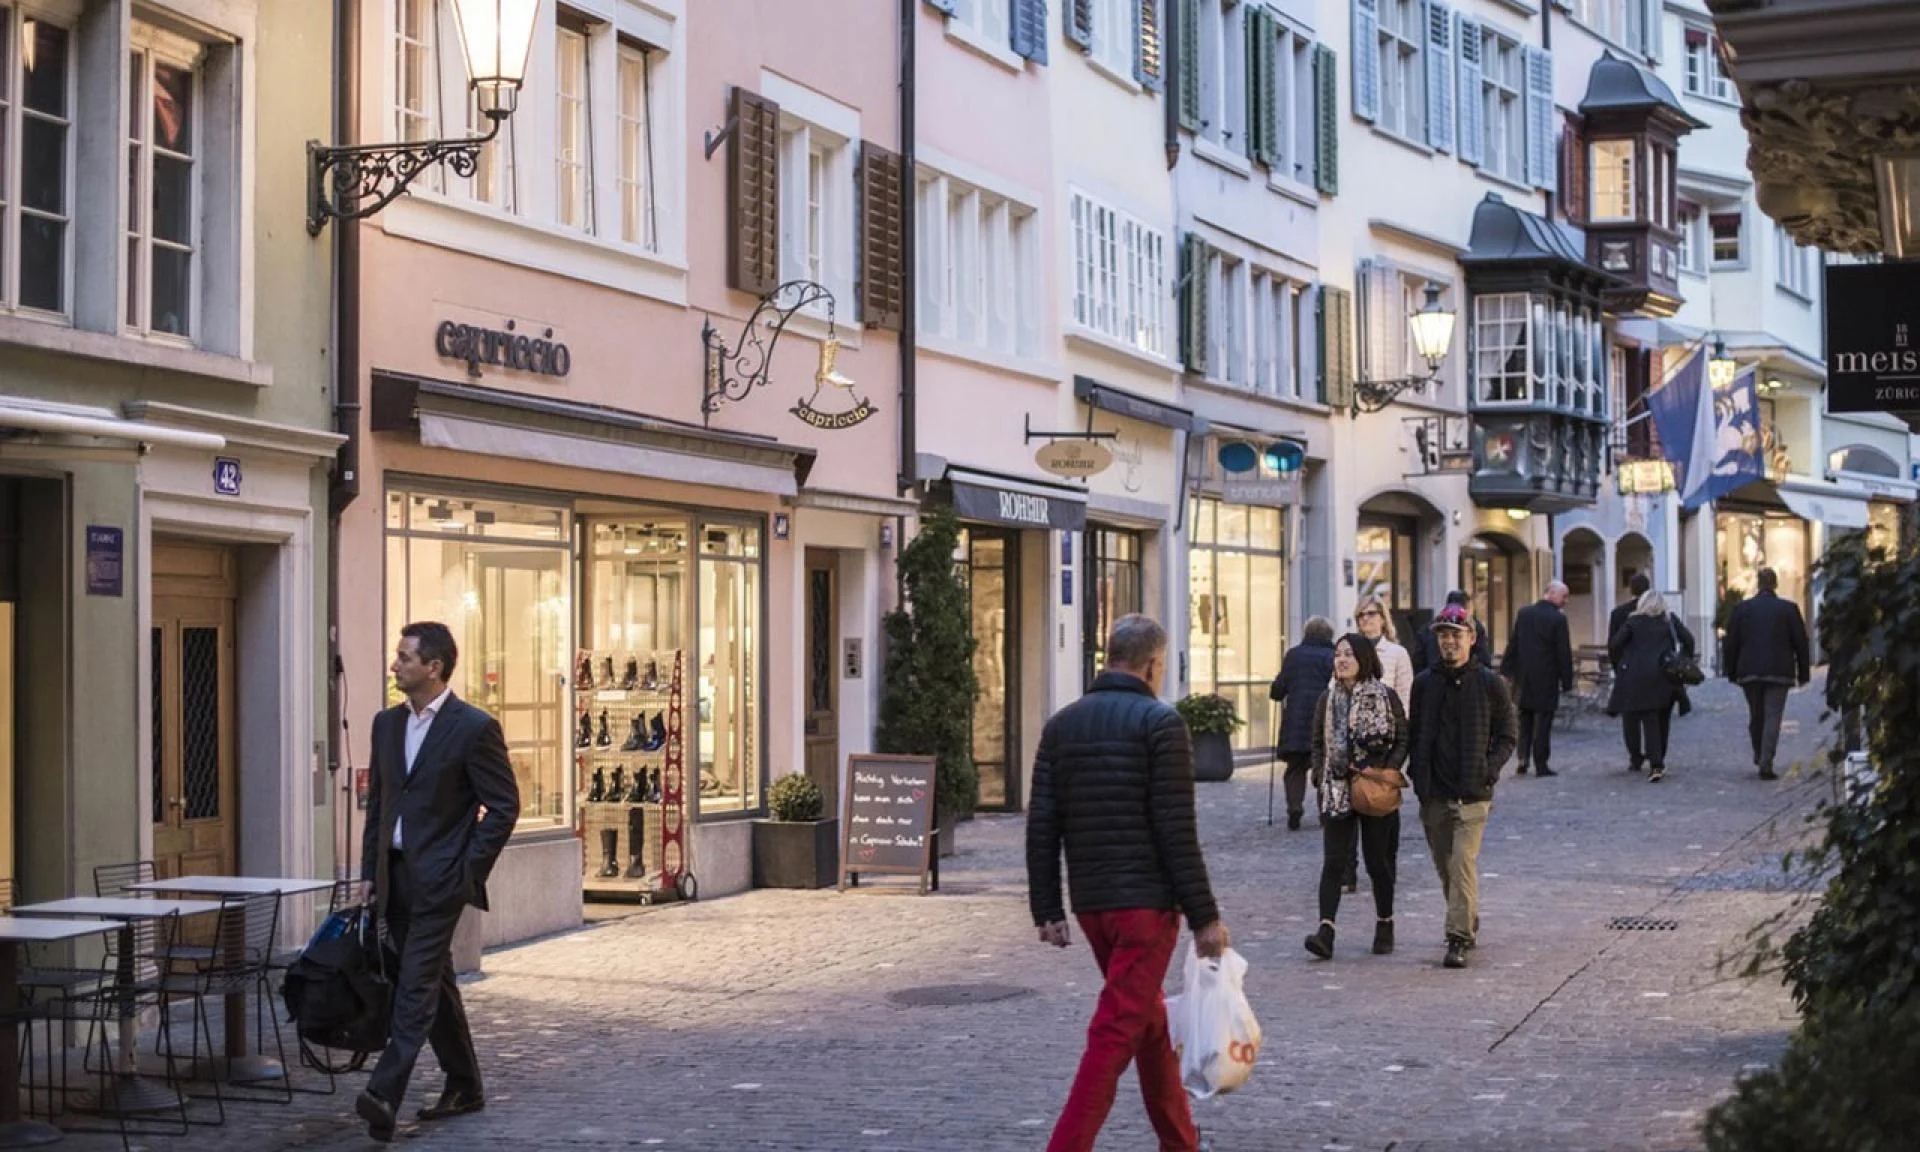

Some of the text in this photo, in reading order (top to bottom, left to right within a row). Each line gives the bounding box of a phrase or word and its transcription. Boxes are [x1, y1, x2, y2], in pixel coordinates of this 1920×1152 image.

[436, 319, 570, 378] capriccio
[799, 407, 868, 428] capriccio
[221, 463, 237, 488] 42
[999, 491, 1049, 525] ROHMIR
